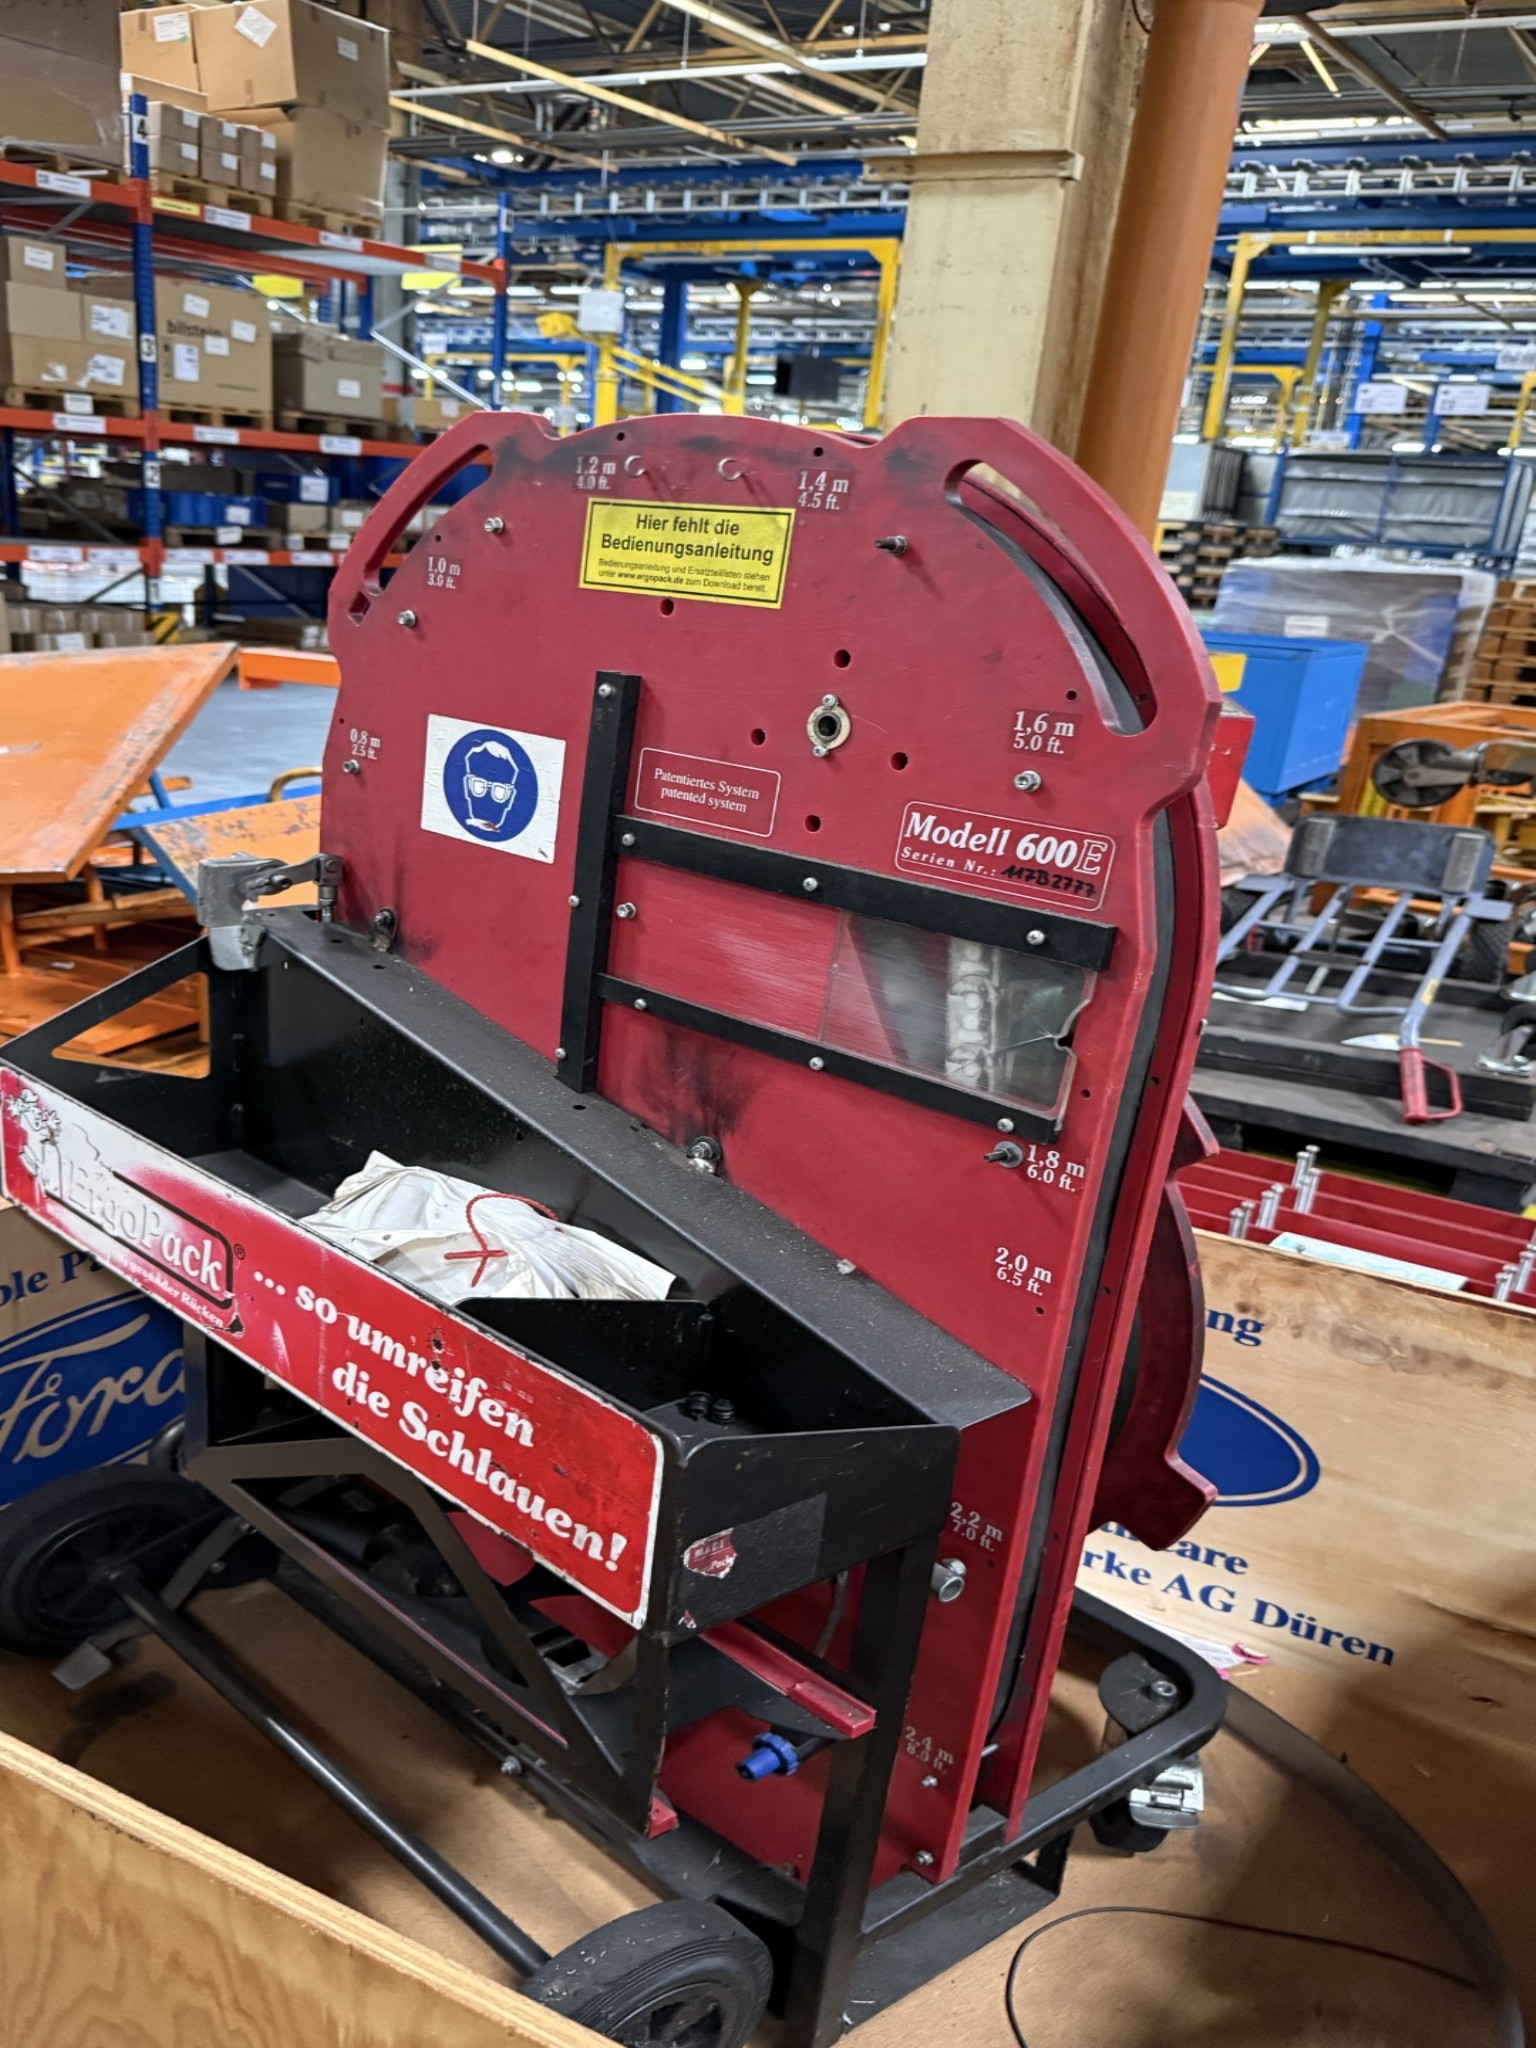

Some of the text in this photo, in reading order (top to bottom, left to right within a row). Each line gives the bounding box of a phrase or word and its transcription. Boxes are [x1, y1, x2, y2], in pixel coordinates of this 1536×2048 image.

[137, 118, 148, 139] 4
[142, 338, 155, 357] 3
[602, 462, 616, 475] m
[798, 470, 849, 493] 1,4 m
[798, 491, 840, 510] 4.5 ft.
[636, 514, 740, 535] Hier fehlt die
[601, 533, 774, 566] Bedienungsanleitung
[428, 556, 461, 576] 1,0 m
[598, 558, 670, 575] Bedienungsanleitung
[672, 565, 686, 574] und
[743, 572, 770, 582] stehen
[598, 570, 617, 578] unter
[617, 571, 683, 585] www.ergopack.de
[685, 578, 701, 586] zum
[703, 578, 741, 591] Download
[1013, 711, 1075, 737] 1,6 m
[370, 737, 381, 748] m
[1013, 732, 1065, 755] 5.0 ft.
[654, 767, 760, 800] Patentiertes System
[660, 787, 747, 813] patented system
[904, 811, 1011, 856] Modell
[900, 846, 955, 868] Serien
[963, 858, 997, 877] Nr.:
[1026, 1144, 1085, 1178] 1,8 m
[1027, 1164, 1076, 1192] 6.0 ft.
[994, 1246, 1052, 1283] 2,0 m
[996, 1266, 1043, 1296] 6.5 ft.
[1205, 1308, 1265, 1347] ng
[294, 1284, 338, 1325] so
[347, 1314, 534, 1448] umreifen
[331, 1361, 628, 1572] die Schlauen!
[950, 1502, 1003, 1542] 2,2 m
[952, 1518, 995, 1553] 7.0 ft.
[1172, 1538, 1249, 1576] are
[1081, 1550, 1395, 1667] rke AG Düren
[905, 1725, 954, 1765] 2,4 m
